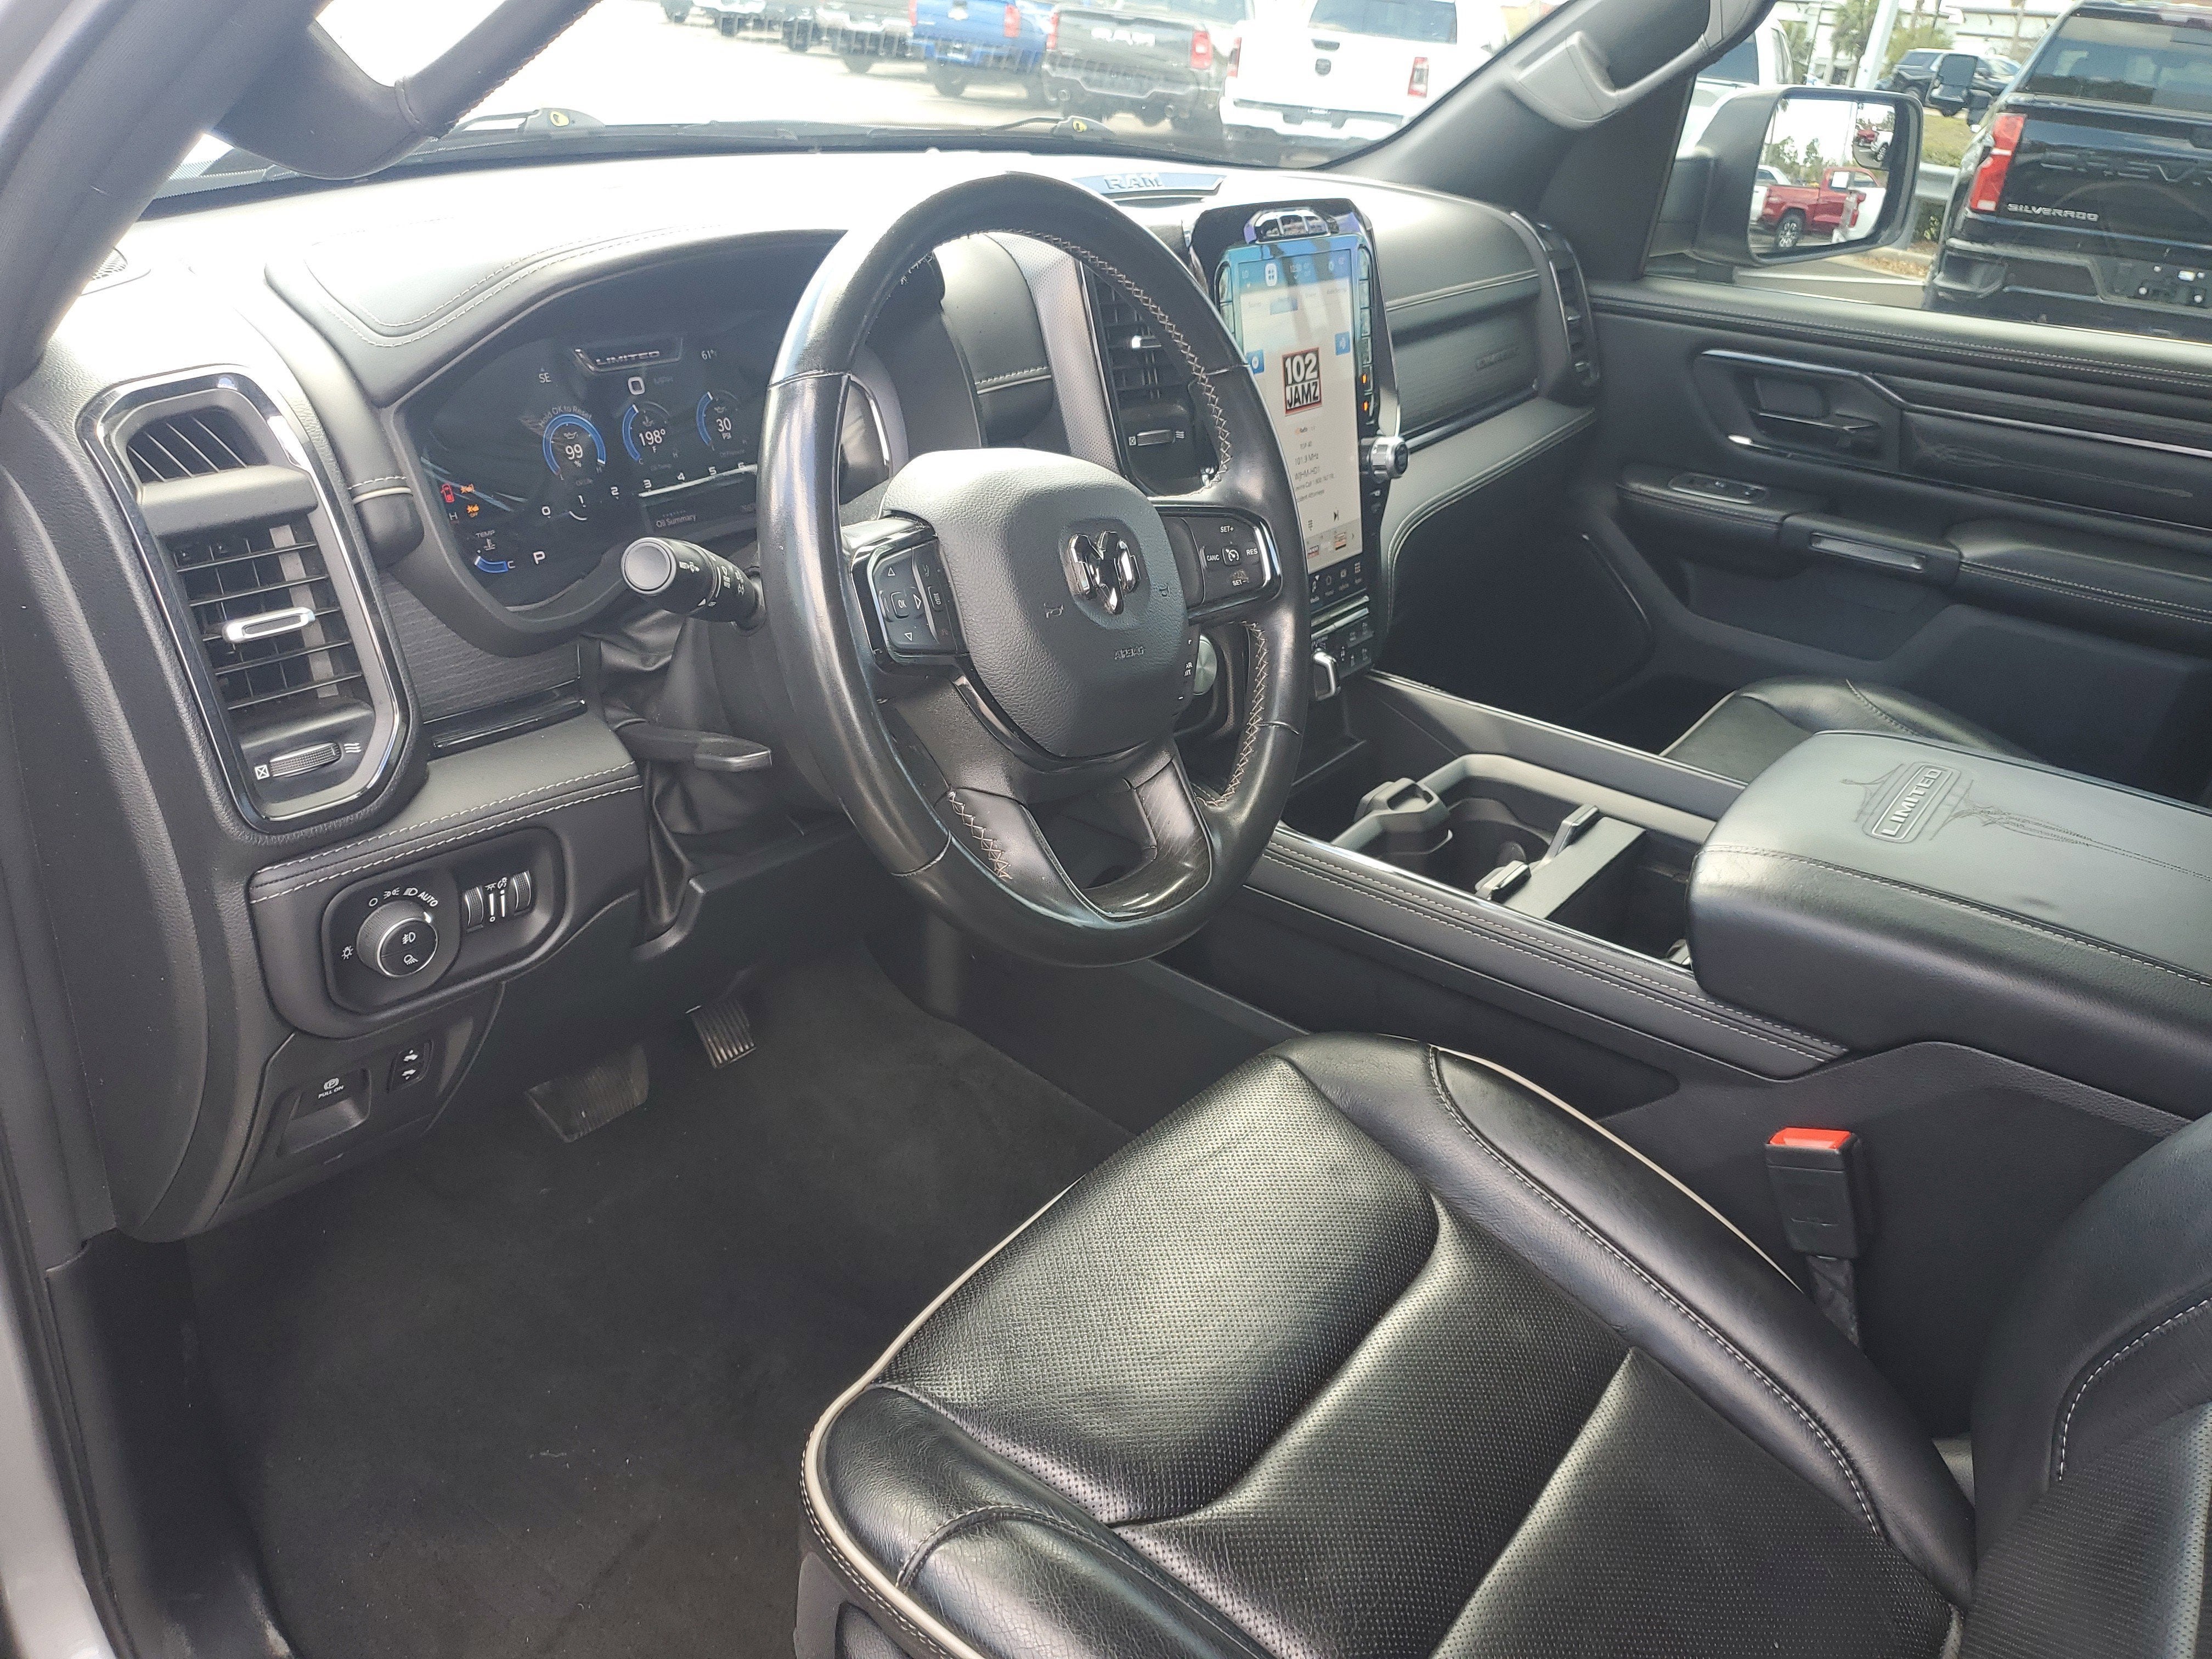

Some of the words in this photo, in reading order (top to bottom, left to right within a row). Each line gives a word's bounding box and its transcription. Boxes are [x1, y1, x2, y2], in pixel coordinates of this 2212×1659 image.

[1103, 173, 1163, 190] RAM
[2007, 202, 2100, 222] SILVERADO
[595, 350, 660, 365] LIMITED
[1284, 352, 1318, 385] 102
[538, 373, 552, 383] SE
[1286, 380, 1319, 409] JAMZ
[716, 417, 732, 432] 30
[565, 443, 583, 460] 99
[610, 486, 619, 496] 2
[642, 478, 652, 489] 3
[676, 471, 686, 481] 4
[1220, 525, 1234, 533] SET+
[533, 550, 546, 565] P
[898, 599, 907, 609] OK
[1881, 768, 1944, 837] LIMITED
[417, 891, 439, 907] AUTO
[318, 1090, 333, 1099] PULL
[333, 1085, 345, 1093] ON
